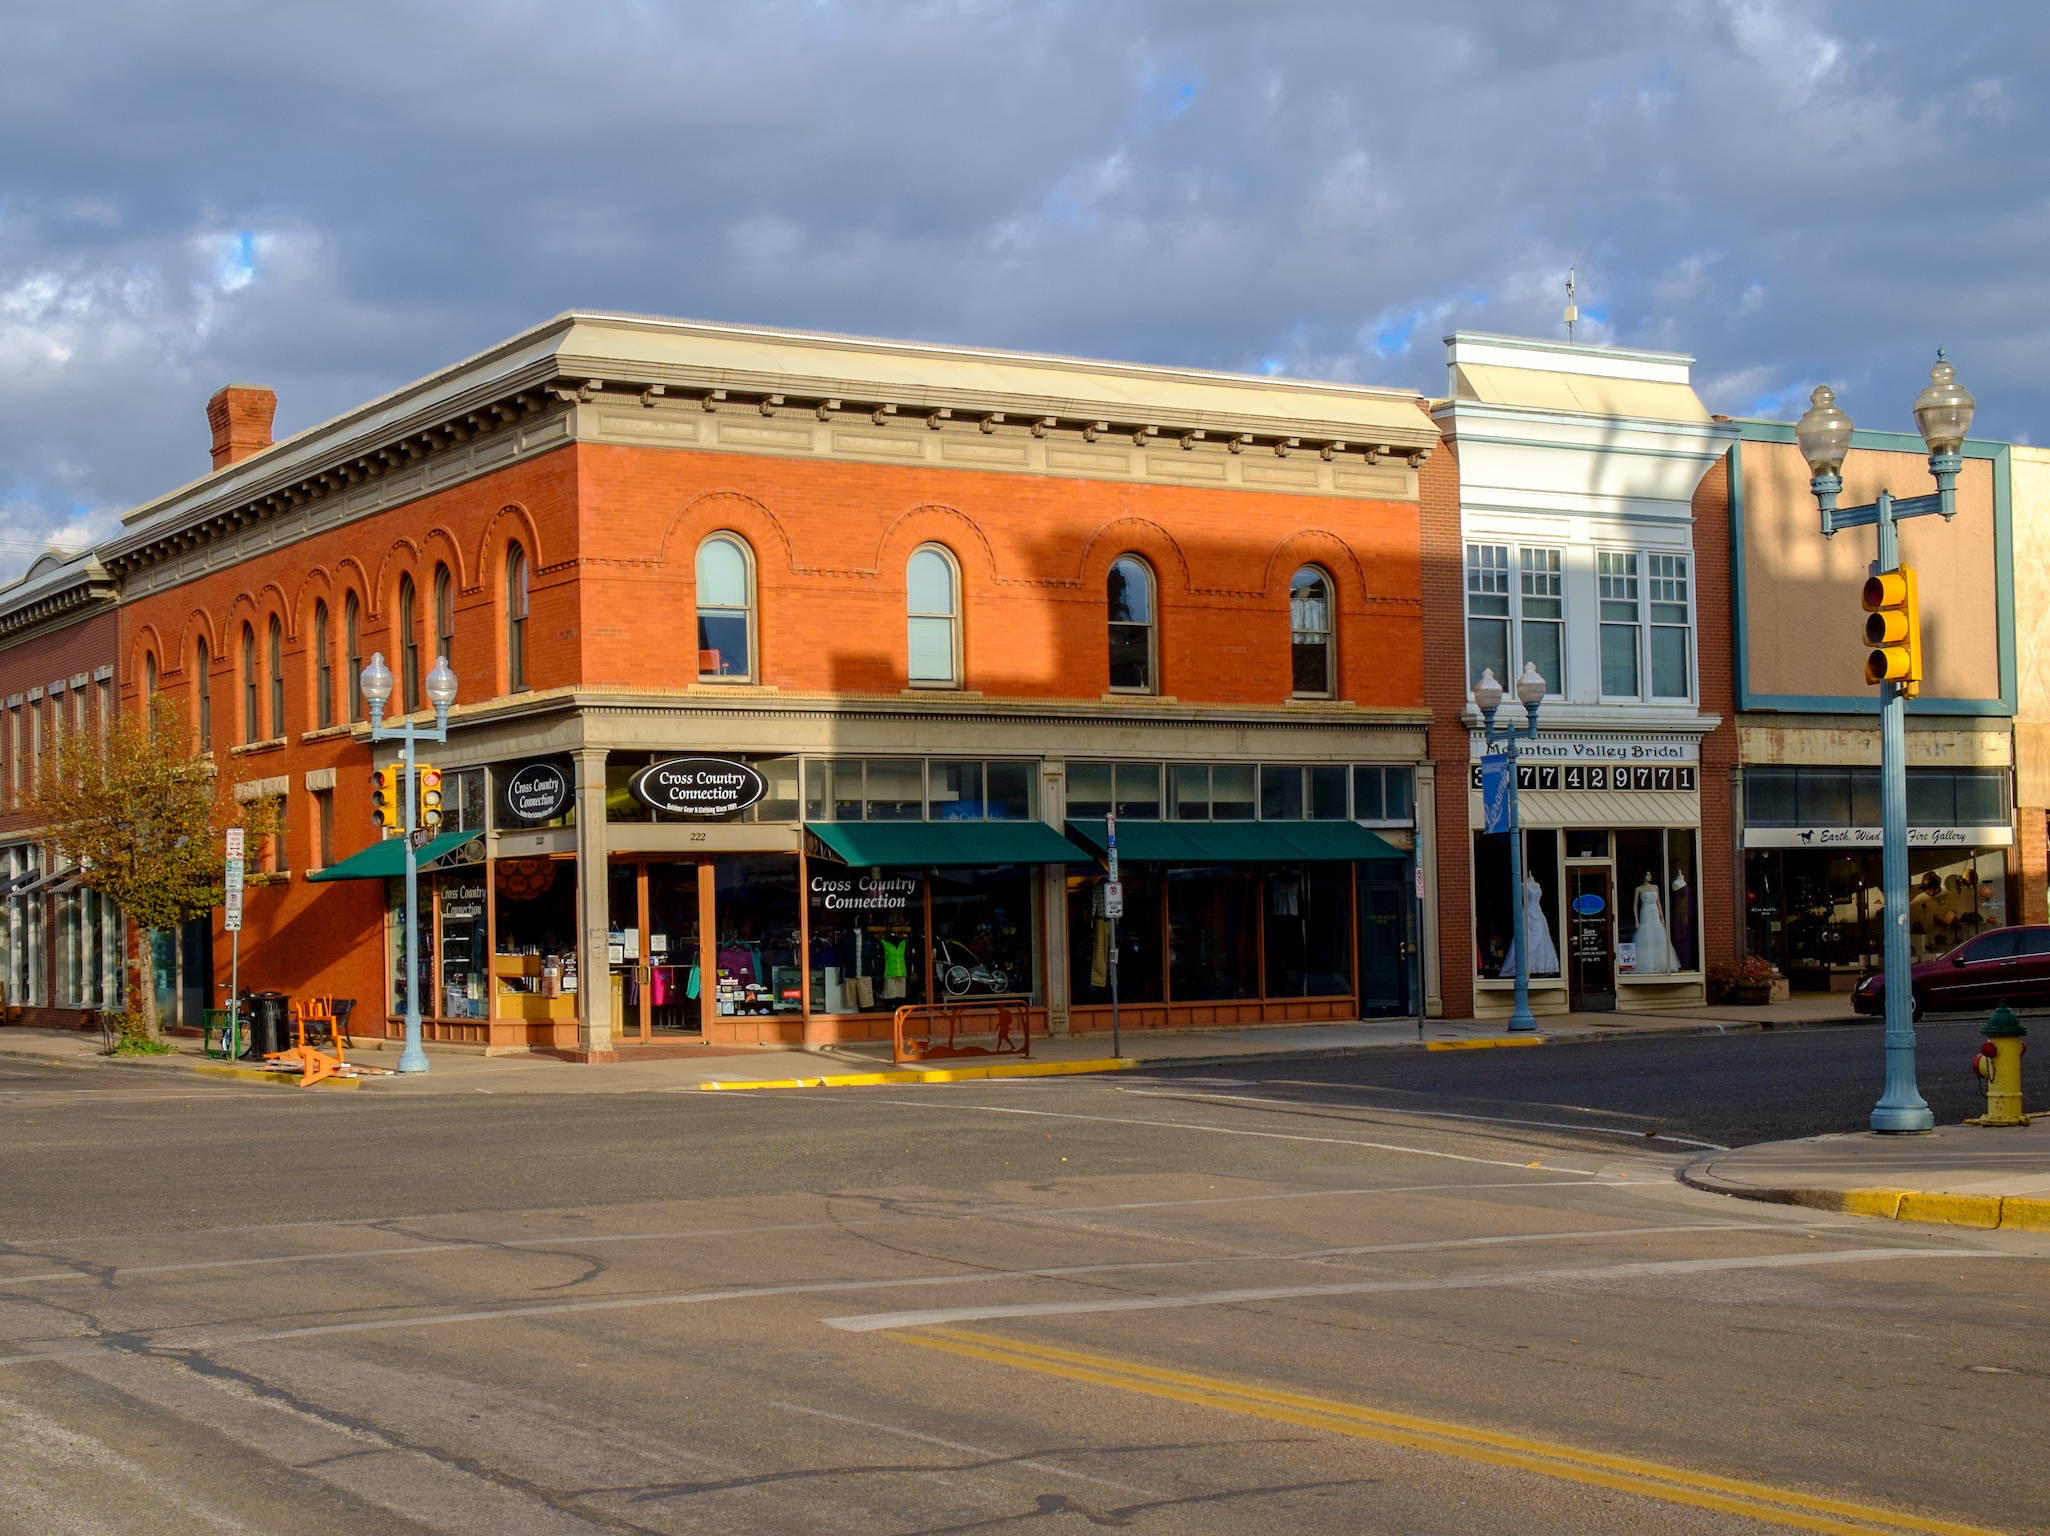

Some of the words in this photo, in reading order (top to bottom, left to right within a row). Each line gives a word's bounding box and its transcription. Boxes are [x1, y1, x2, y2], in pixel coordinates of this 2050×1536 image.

[1572, 744, 1627, 759] Valley
[1631, 744, 1684, 758] Bridal
[659, 771, 693, 785] Cross
[696, 771, 746, 789] Country
[1474, 766, 1691, 788] 377429771
[514, 781, 533, 794] Cross
[533, 778, 559, 793] Country
[669, 787, 738, 800] Connection
[520, 793, 555, 808] Connection
[1484, 769, 1510, 830] Laramie
[666, 803, 684, 812] Outdoor
[698, 806, 716, 814] Clothing
[690, 832, 706, 841] 222
[1908, 829, 1928, 842] Fire
[1931, 829, 1966, 844] Gallery
[810, 876, 852, 892] Cross
[858, 876, 916, 895] Country
[441, 886, 459, 900] Cross
[460, 885, 486, 902] Country
[825, 893, 906, 909] Connection
[446, 902, 482, 915] Connection
